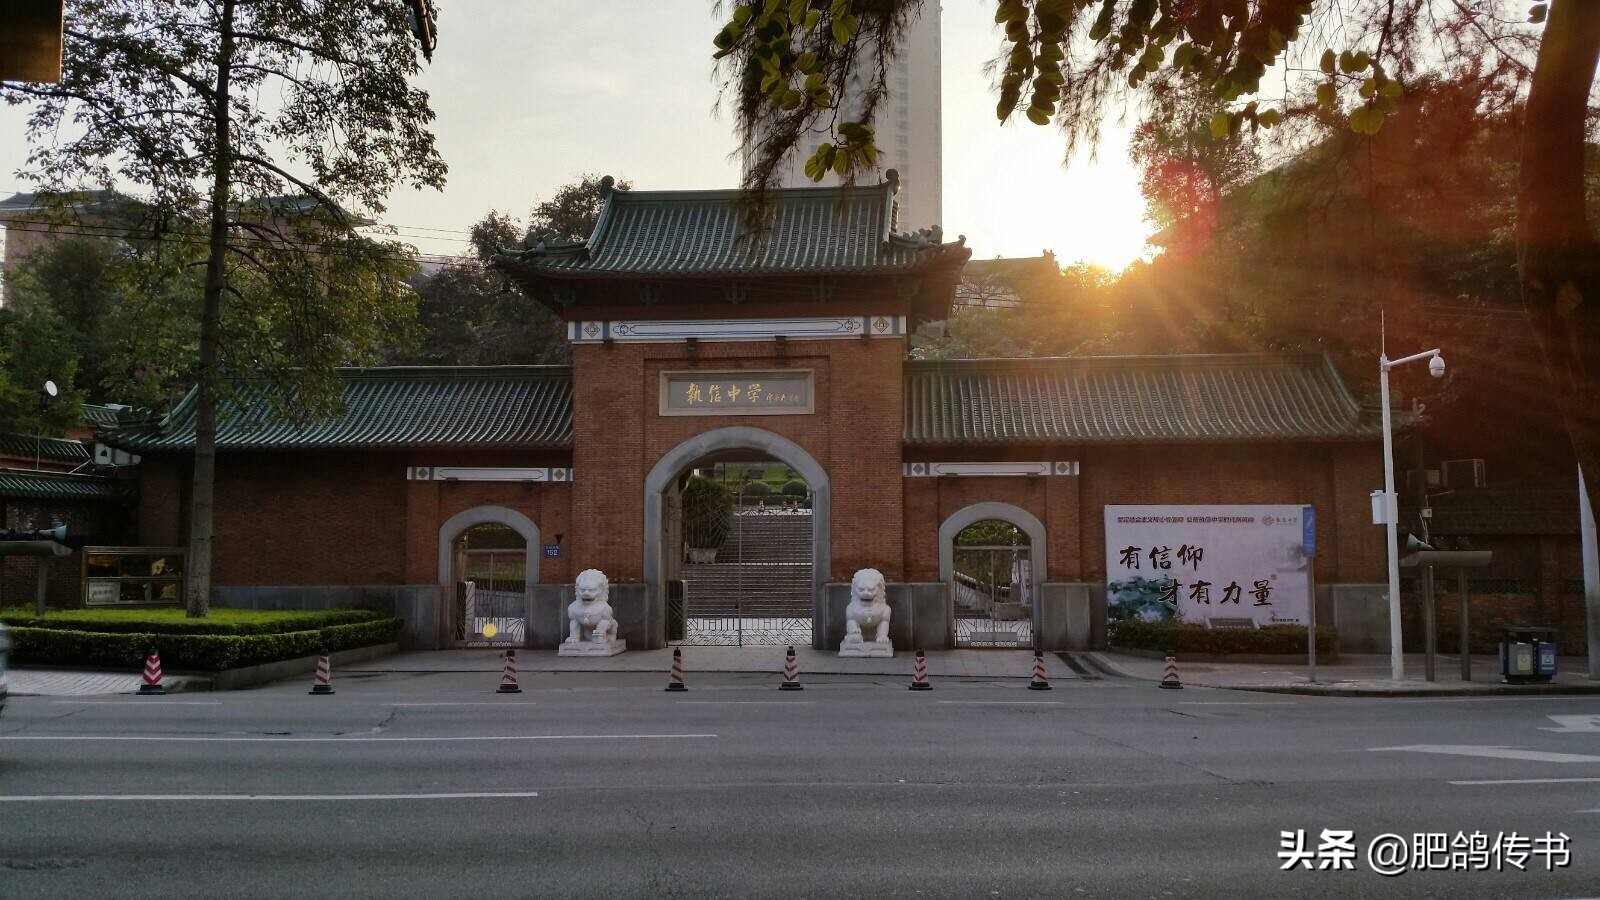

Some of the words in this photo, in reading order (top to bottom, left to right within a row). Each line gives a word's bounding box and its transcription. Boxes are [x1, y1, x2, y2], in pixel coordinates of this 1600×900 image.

[1119, 544, 1204, 571] 有信仰
[1158, 578, 1274, 607] 才有力量
